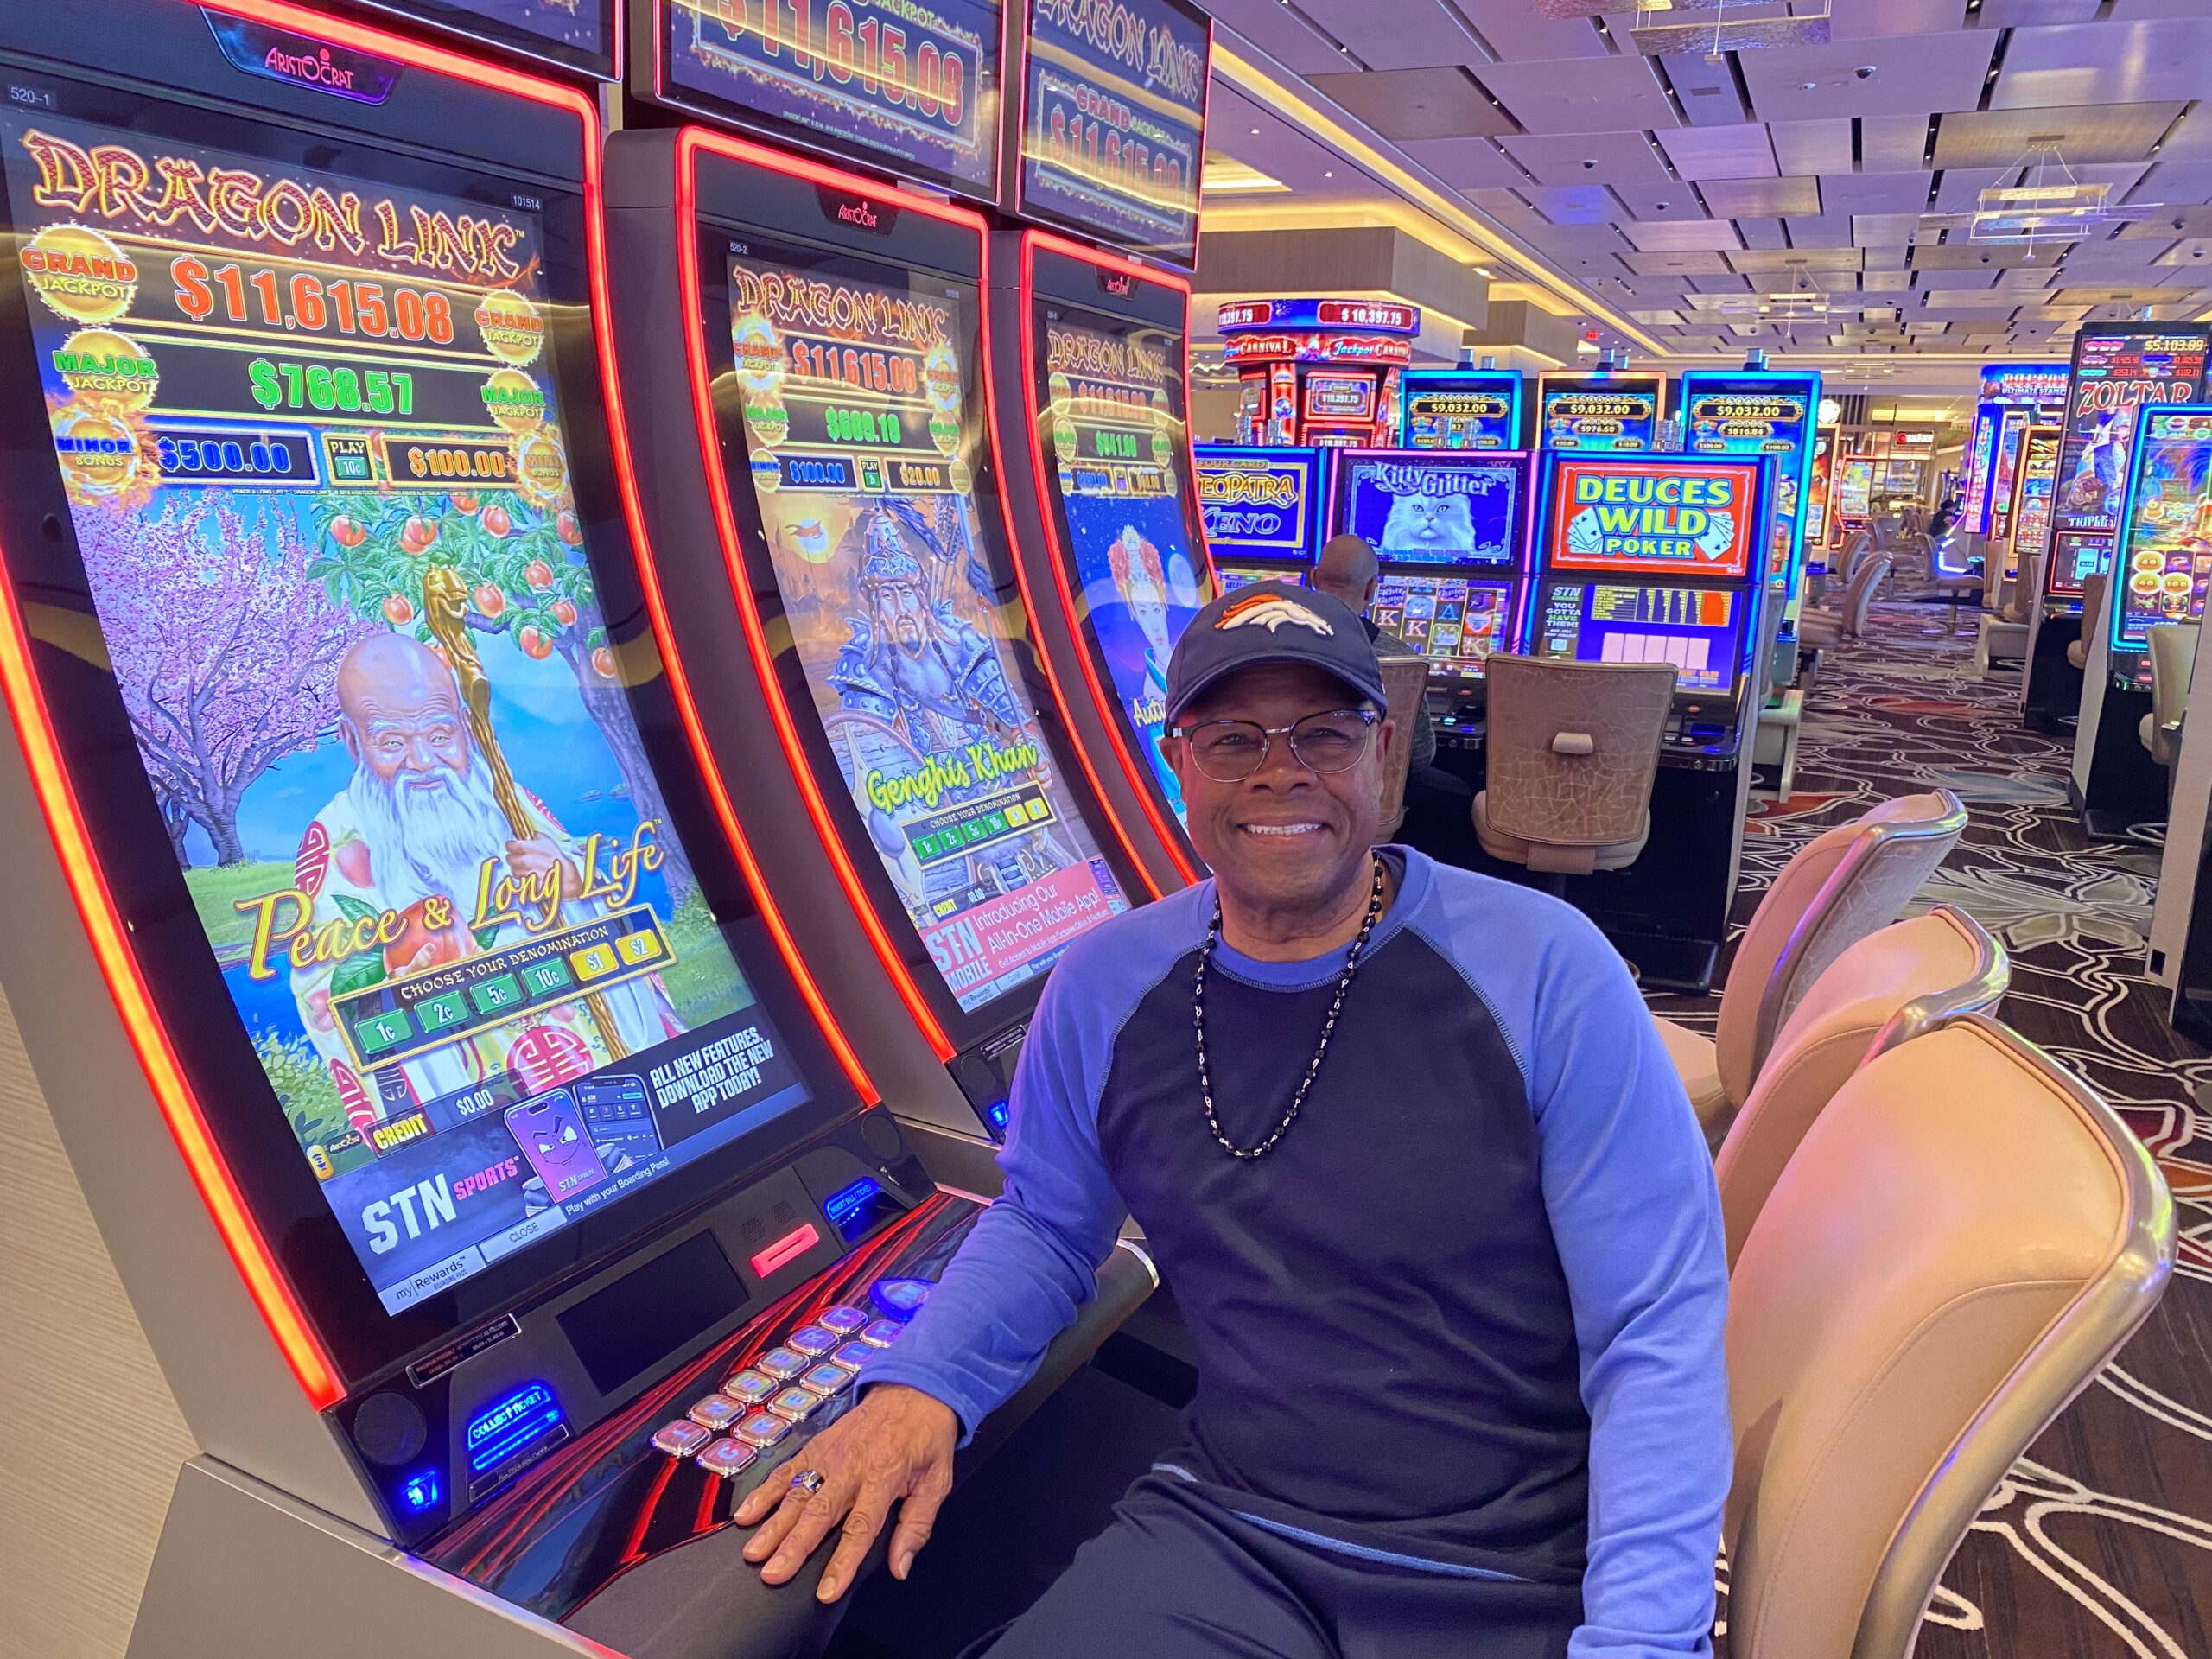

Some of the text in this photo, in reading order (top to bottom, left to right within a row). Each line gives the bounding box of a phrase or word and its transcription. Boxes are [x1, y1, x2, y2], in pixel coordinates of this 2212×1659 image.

[264, 47, 353, 90] ARISTOCRAT
[10, 86, 50, 107] 520-1
[1075, 84, 1131, 132] GRAND
[22, 127, 368, 257] DRAGON
[512, 195, 540, 211] 101514
[838, 201, 877, 228] ARISTOCRAT
[20, 246, 137, 283] GRAND
[41, 276, 130, 300] JACKPOT
[171, 254, 454, 346] $11,615.08
[734, 264, 877, 335] DRAGON
[474, 307, 544, 334] GRAND
[486, 331, 537, 346] JACKPOT
[734, 341, 780, 361] GRAND
[1048, 328, 1123, 376] DRAGON
[1240, 340, 1293, 355] CARNIVAL
[1332, 341, 1374, 358] Jackpot
[52, 349, 159, 380] MAJOR
[742, 359, 776, 372] JACKPOT
[791, 339, 918, 394] $11,615.08
[73, 378, 149, 394] JACKPOT
[247, 358, 413, 415] $768.57
[480, 385, 544, 407] MAJOR
[2076, 380, 2193, 418] ZOLTAR
[493, 405, 541, 420] JACKPOT
[746, 405, 788, 423] MAJOR
[55, 435, 134, 455] MINOR
[157, 436, 291, 474] $500.00
[330, 441, 365, 454] PLAY
[75, 455, 124, 468] BONUS
[342, 460, 360, 476] 10¢
[408, 446, 506, 478] $100.00
[531, 467, 560, 477] BONUS
[862, 461, 878, 471] PLAY
[1198, 460, 1266, 470] FOUR CARD
[1198, 474, 1296, 508] EOPATRA
[1374, 461, 1492, 498] Kitty Glitter
[1577, 476, 1732, 506] DEUCES
[1597, 506, 1708, 536] WILD
[1605, 536, 1694, 556] POKER
[2140, 558, 2158, 567] 40
[1552, 586, 1581, 596] STN
[1132, 695, 1166, 728] Autu
[866, 742, 1039, 815] Genghis Khan
[930, 792, 1022, 830] CHOOSE YOUR DENOMINATION
[235, 887, 409, 982] Peace
[422, 897, 452, 931] &
[468, 857, 563, 939] Long
[971, 883, 1058, 932] Introducing Our
[987, 917, 1043, 955] All-In-One
[1038, 900, 1077, 928] Mobile
[1076, 887, 1102, 912] App!
[925, 917, 983, 973] STN
[399, 925, 609, 1001] CHOOSE YOUR DENOMINATION
[944, 956, 993, 995] MOBILE
[998, 957, 1010, 969] Get
[376, 937, 648, 1043] 1¢ 2¢ 5¢ 10¢ $1 $2
[649, 1026, 766, 1089] ALL NEW FEATURES,
[655, 1039, 775, 1109] DOWNLOAD THE NEW
[455, 1088, 495, 1117] $0.00
[690, 1066, 763, 1115] APP TODAY!
[372, 1112, 429, 1152] CREDIT
[558, 1173, 578, 1194] STN
[564, 1156, 671, 1217] Play with your Boarding Pass!
[360, 1172, 458, 1255] STN
[508, 1221, 540, 1244] CLOSE
[433, 1274, 457, 1291] BOARDING
